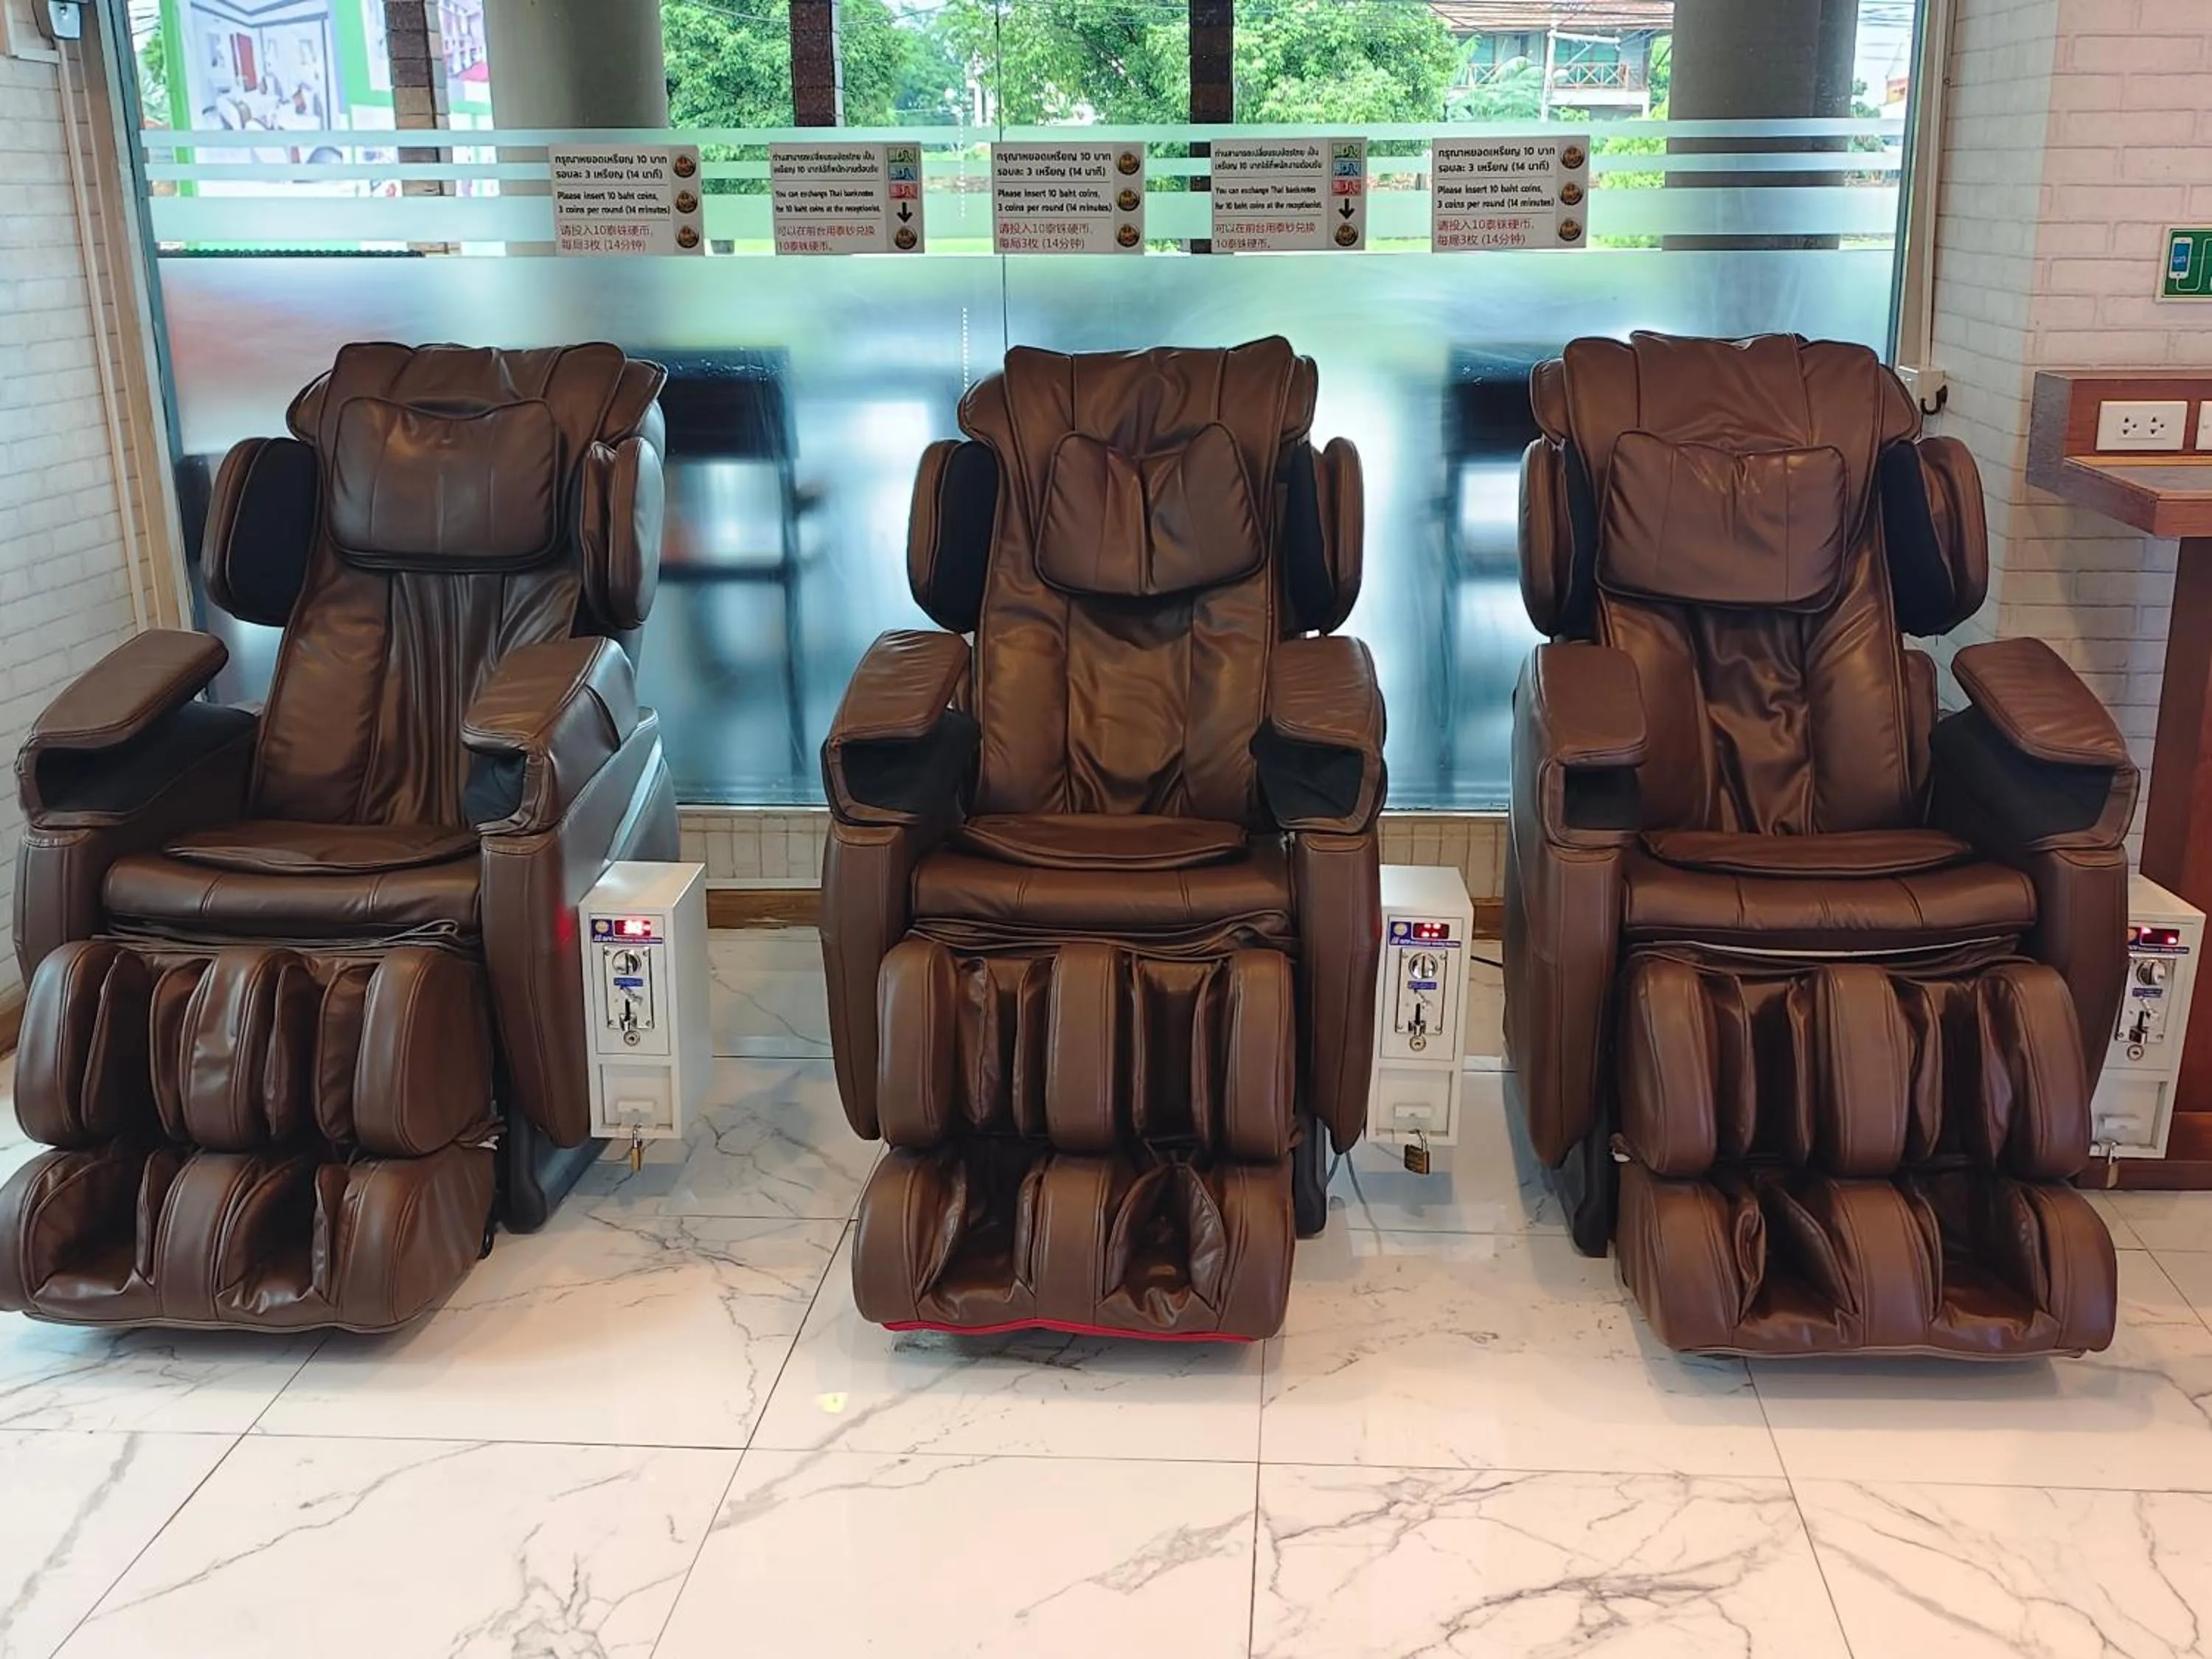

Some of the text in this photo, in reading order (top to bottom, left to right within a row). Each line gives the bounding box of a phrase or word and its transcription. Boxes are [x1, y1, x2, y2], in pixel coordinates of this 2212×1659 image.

[1523, 147, 1534, 156] 10
[1537, 147, 1555, 156] บาท
[637, 155, 647, 164] 10
[650, 156, 667, 164] บาท
[1080, 153, 1091, 161] 10
[1094, 153, 1111, 161] บาท
[1239, 161, 1248, 170] 10
[1468, 164, 1474, 172] 3
[1477, 161, 1508, 172] เหรียญ
[1512, 162, 1525, 172] (14
[1528, 160, 1549, 171] นาที)
[585, 170, 591, 178] 3
[594, 168, 624, 179] เหรียญ
[626, 170, 639, 179] (14
[642, 168, 663, 179] นาที)
[1027, 167, 1032, 176] 3
[1035, 166, 1065, 177] เหรียญ
[1068, 167, 1082, 177] (14
[1085, 166, 1106, 177] นาที)
[998, 189, 1021, 198] Please
[1024, 189, 1046, 198] insert
[1048, 189, 1057, 198] 10
[1059, 189, 1077, 198] baht
[1214, 187, 1227, 195] You
[1241, 186, 1269, 195] exchange
[1437, 186, 1462, 194] Please
[1465, 185, 1487, 193] insert
[1490, 185, 1499, 193] 10
[1500, 184, 1518, 192] baht
[557, 191, 581, 200] Please
[583, 192, 605, 200] insert
[608, 192, 616, 200] 10
[618, 192, 635, 200] baht
[800, 190, 828, 198] exchange
[809, 204, 824, 212] coins
[834, 204, 844, 212] the
[998, 204, 1113, 213] 3 coins per round (14 minutes)
[1249, 201, 1265, 209] coins
[1437, 198, 1555, 210] 3 coins per round (14 minutes)
[566, 205, 585, 213] coins
[586, 207, 599, 215] per
[625, 205, 636, 215] (14
[638, 205, 670, 215] minutes)
